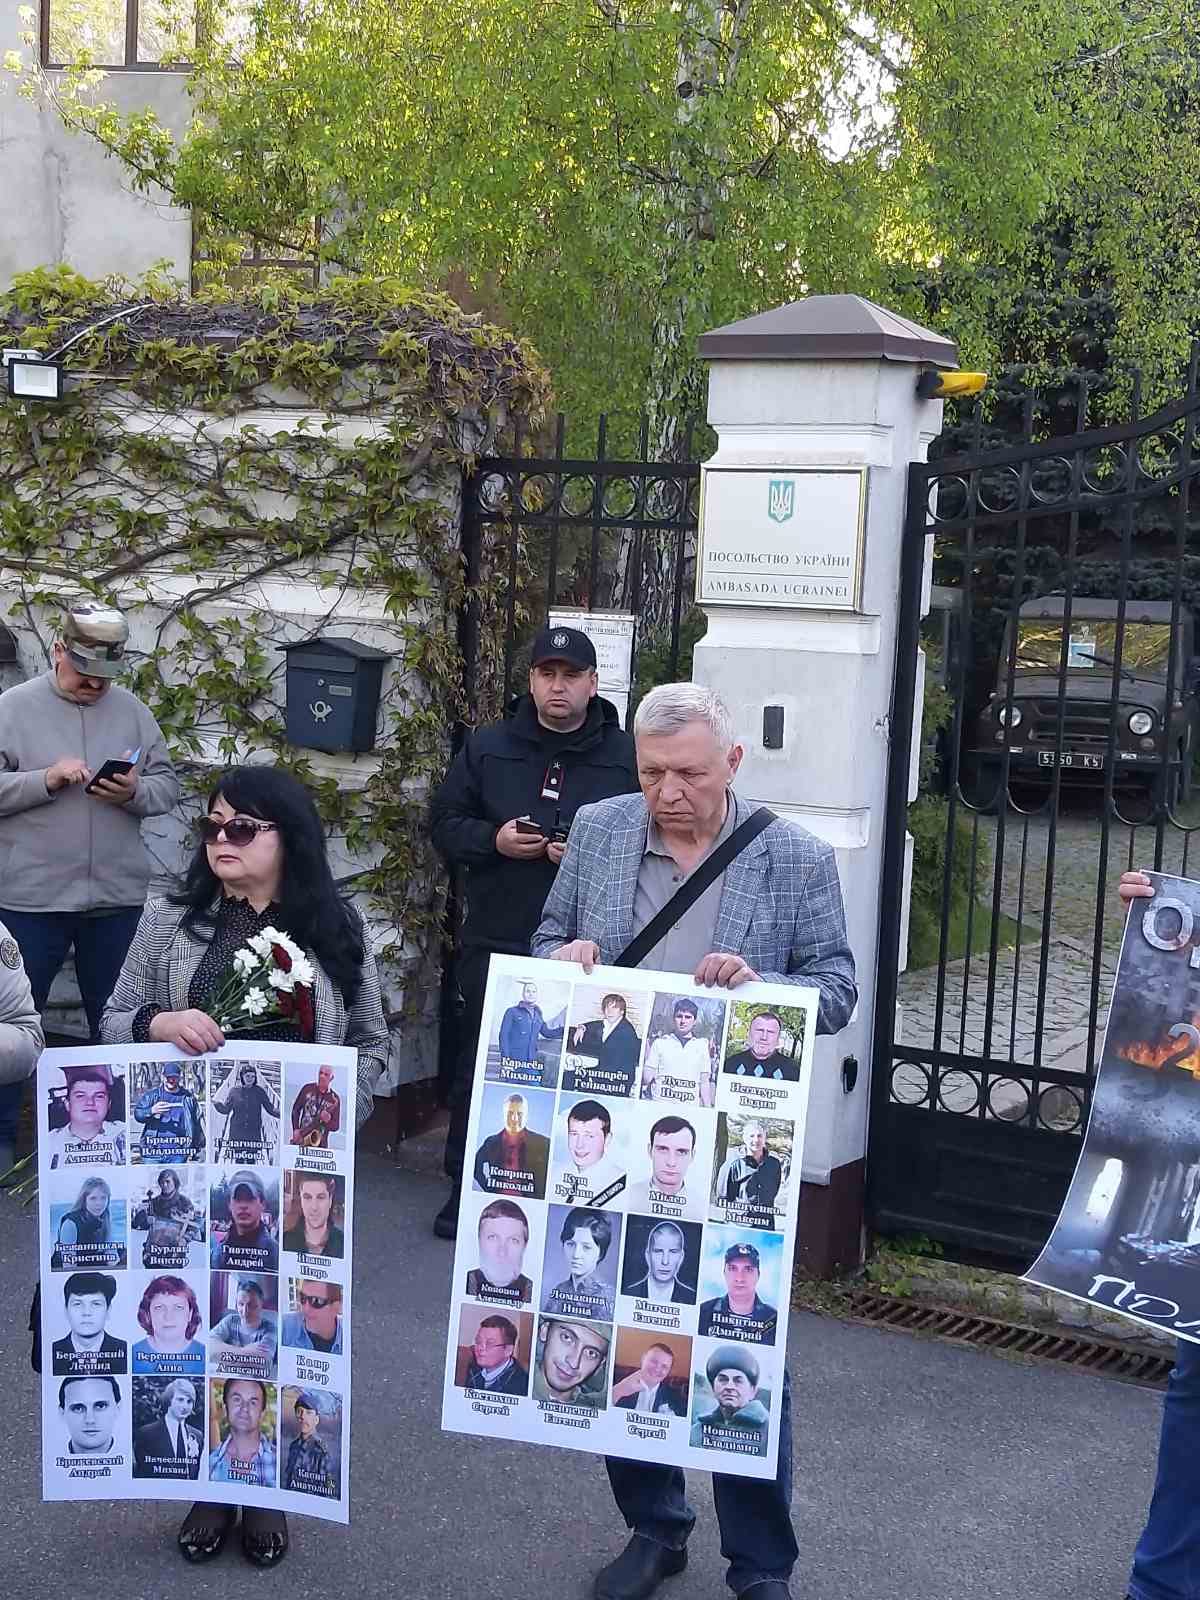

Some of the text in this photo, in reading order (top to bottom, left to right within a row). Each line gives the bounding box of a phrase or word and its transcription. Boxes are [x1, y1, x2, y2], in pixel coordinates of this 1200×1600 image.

[708, 551, 850, 567] ПОСОЛЬСТВО УКРАЇНИ
[707, 580, 848, 597] AMBASADA UCRAINEI
[502, 1057, 544, 1070] Карасёв
[500, 1070, 542, 1083] Михаил
[574, 1067, 628, 1082] Кушнарёв
[661, 1087, 695, 1101] Игорь
[740, 1096, 776, 1110] Вадим
[64, 1152, 112, 1164] Алексей
[490, 1166, 534, 1180] Коврига
[487, 1178, 534, 1192] Николай
[652, 1203, 682, 1216] Иван
[725, 1211, 770, 1226] Максим
[63, 1253, 117, 1265] Кристина
[150, 1256, 190, 1268] Виктор
[226, 1256, 264, 1268] Андрей
[562, 1303, 592, 1316] Нина
[1087, 1273, 1200, 1335] ПО
[709, 1325, 763, 1342] Дмитрий
[56, 1349, 124, 1363] Березовский
[69, 1360, 111, 1371] Леонид
[156, 1362, 184, 1373] Анна
[296, 1367, 330, 1385] Пётр
[472, 1401, 510, 1416] Сергей
[628, 1424, 667, 1440] Сергей
[703, 1424, 761, 1442] Новицкий
[703, 1436, 760, 1455] Владимир
[69, 1467, 112, 1479] Андрей
